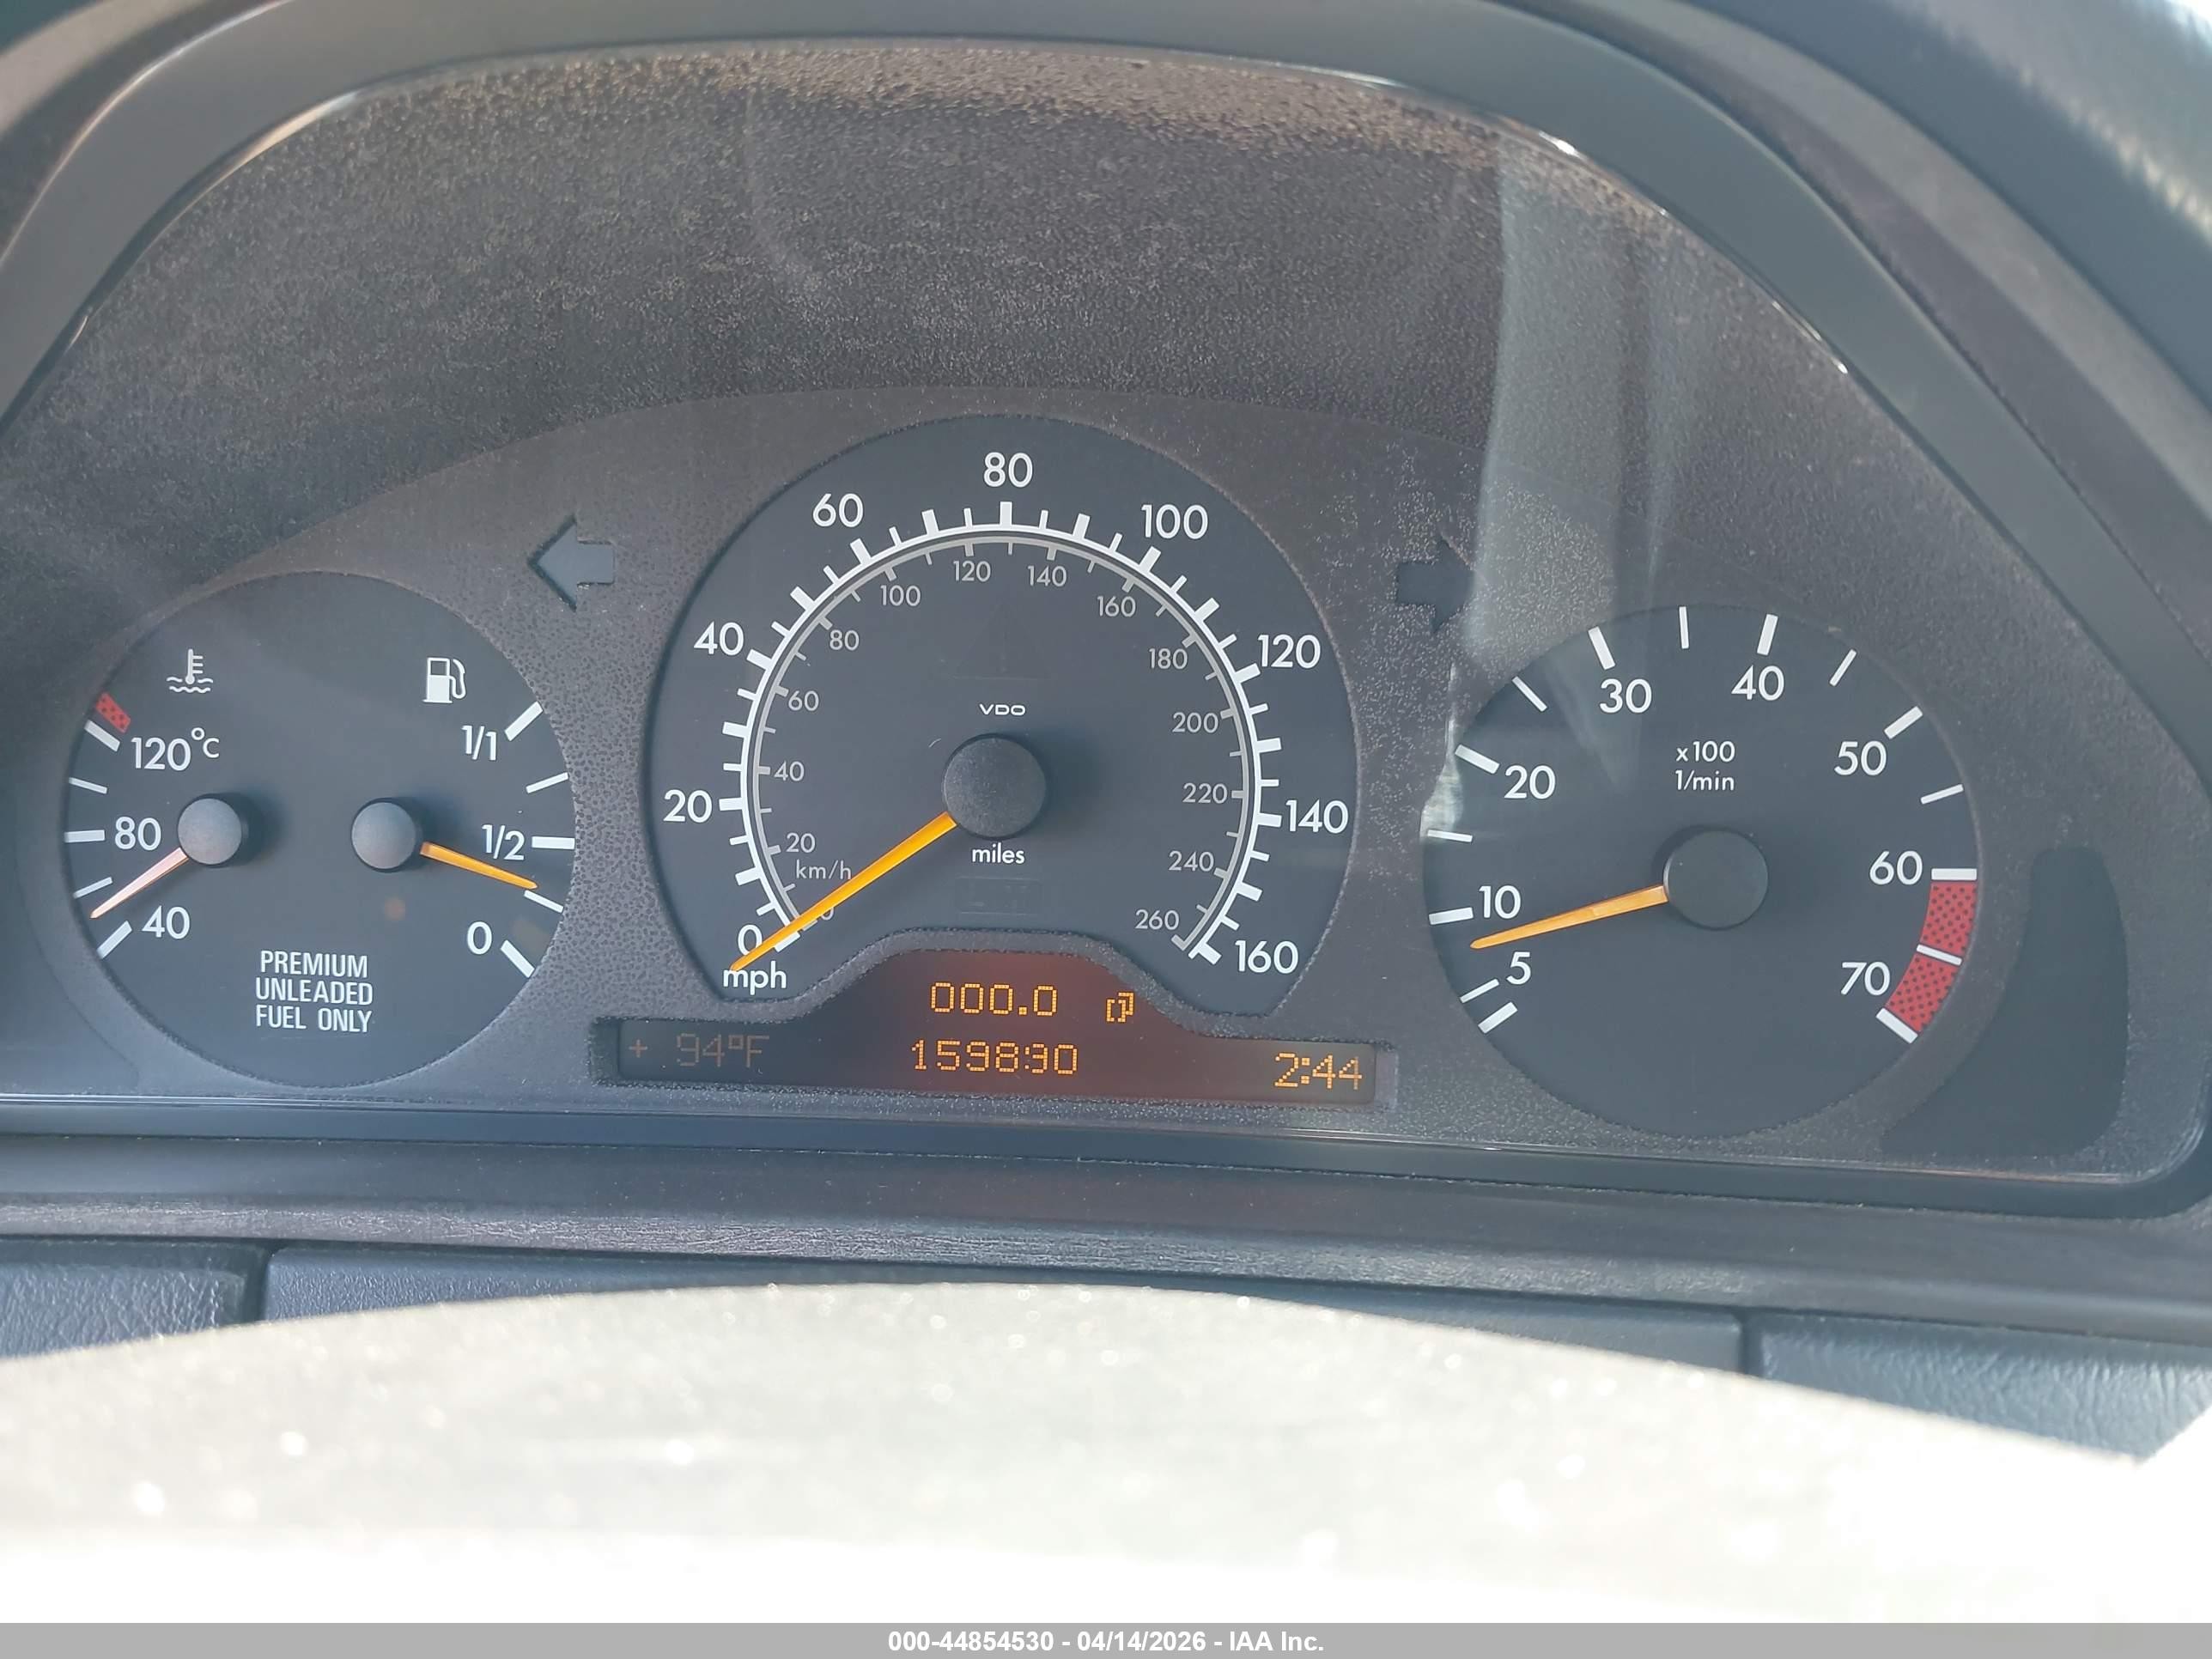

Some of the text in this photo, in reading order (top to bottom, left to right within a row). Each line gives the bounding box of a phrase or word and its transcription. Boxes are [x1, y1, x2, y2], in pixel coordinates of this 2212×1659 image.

[983, 451, 1034, 489] 80
[811, 492, 864, 528] 60
[1140, 502, 1209, 540] 100
[952, 560, 991, 582] 120
[1027, 564, 1067, 587] 140
[879, 585, 921, 607] 100
[1097, 595, 1136, 618] 160
[693, 621, 744, 657] 40
[829, 629, 860, 652] 80
[1257, 634, 1322, 670] 120
[1149, 648, 1188, 670] 180
[1599, 678, 1652, 714] 30
[1731, 665, 1784, 701] 40
[787, 690, 819, 712] 60
[979, 703, 1026, 717] VDO
[1171, 711, 1219, 734] 200
[131, 736, 192, 772] 120
[461, 724, 499, 762] 1/1
[1833, 740, 1887, 776] 50
[774, 760, 805, 782] 40
[1504, 764, 1556, 800] 20
[1674, 769, 1735, 791] 1/min
[664, 788, 713, 823] 20
[1182, 782, 1228, 804] 220
[113, 816, 162, 850] 80
[1285, 799, 1349, 834] 140
[482, 824, 526, 861] 1/2
[785, 833, 817, 854] 20
[971, 842, 1024, 865] miles
[795, 859, 853, 880] km/h
[1168, 850, 1215, 872] 240
[1869, 850, 1923, 885] 60
[1478, 884, 1522, 920] 10
[141, 906, 191, 939] 40
[1134, 909, 1181, 931] 260
[466, 921, 493, 955] 0
[737, 923, 764, 957] 0
[259, 950, 368, 979] PREMIUM
[1234, 940, 1299, 975] 160
[1507, 951, 1531, 986] 5
[255, 977, 373, 1006] UNLEADED
[722, 960, 787, 996] mph
[1840, 961, 1891, 996] 70
[930, 981, 1058, 1017] 000.0
[256, 1005, 372, 1033] FUEL ONLY
[1274, 1052, 1363, 1090] 2:44
